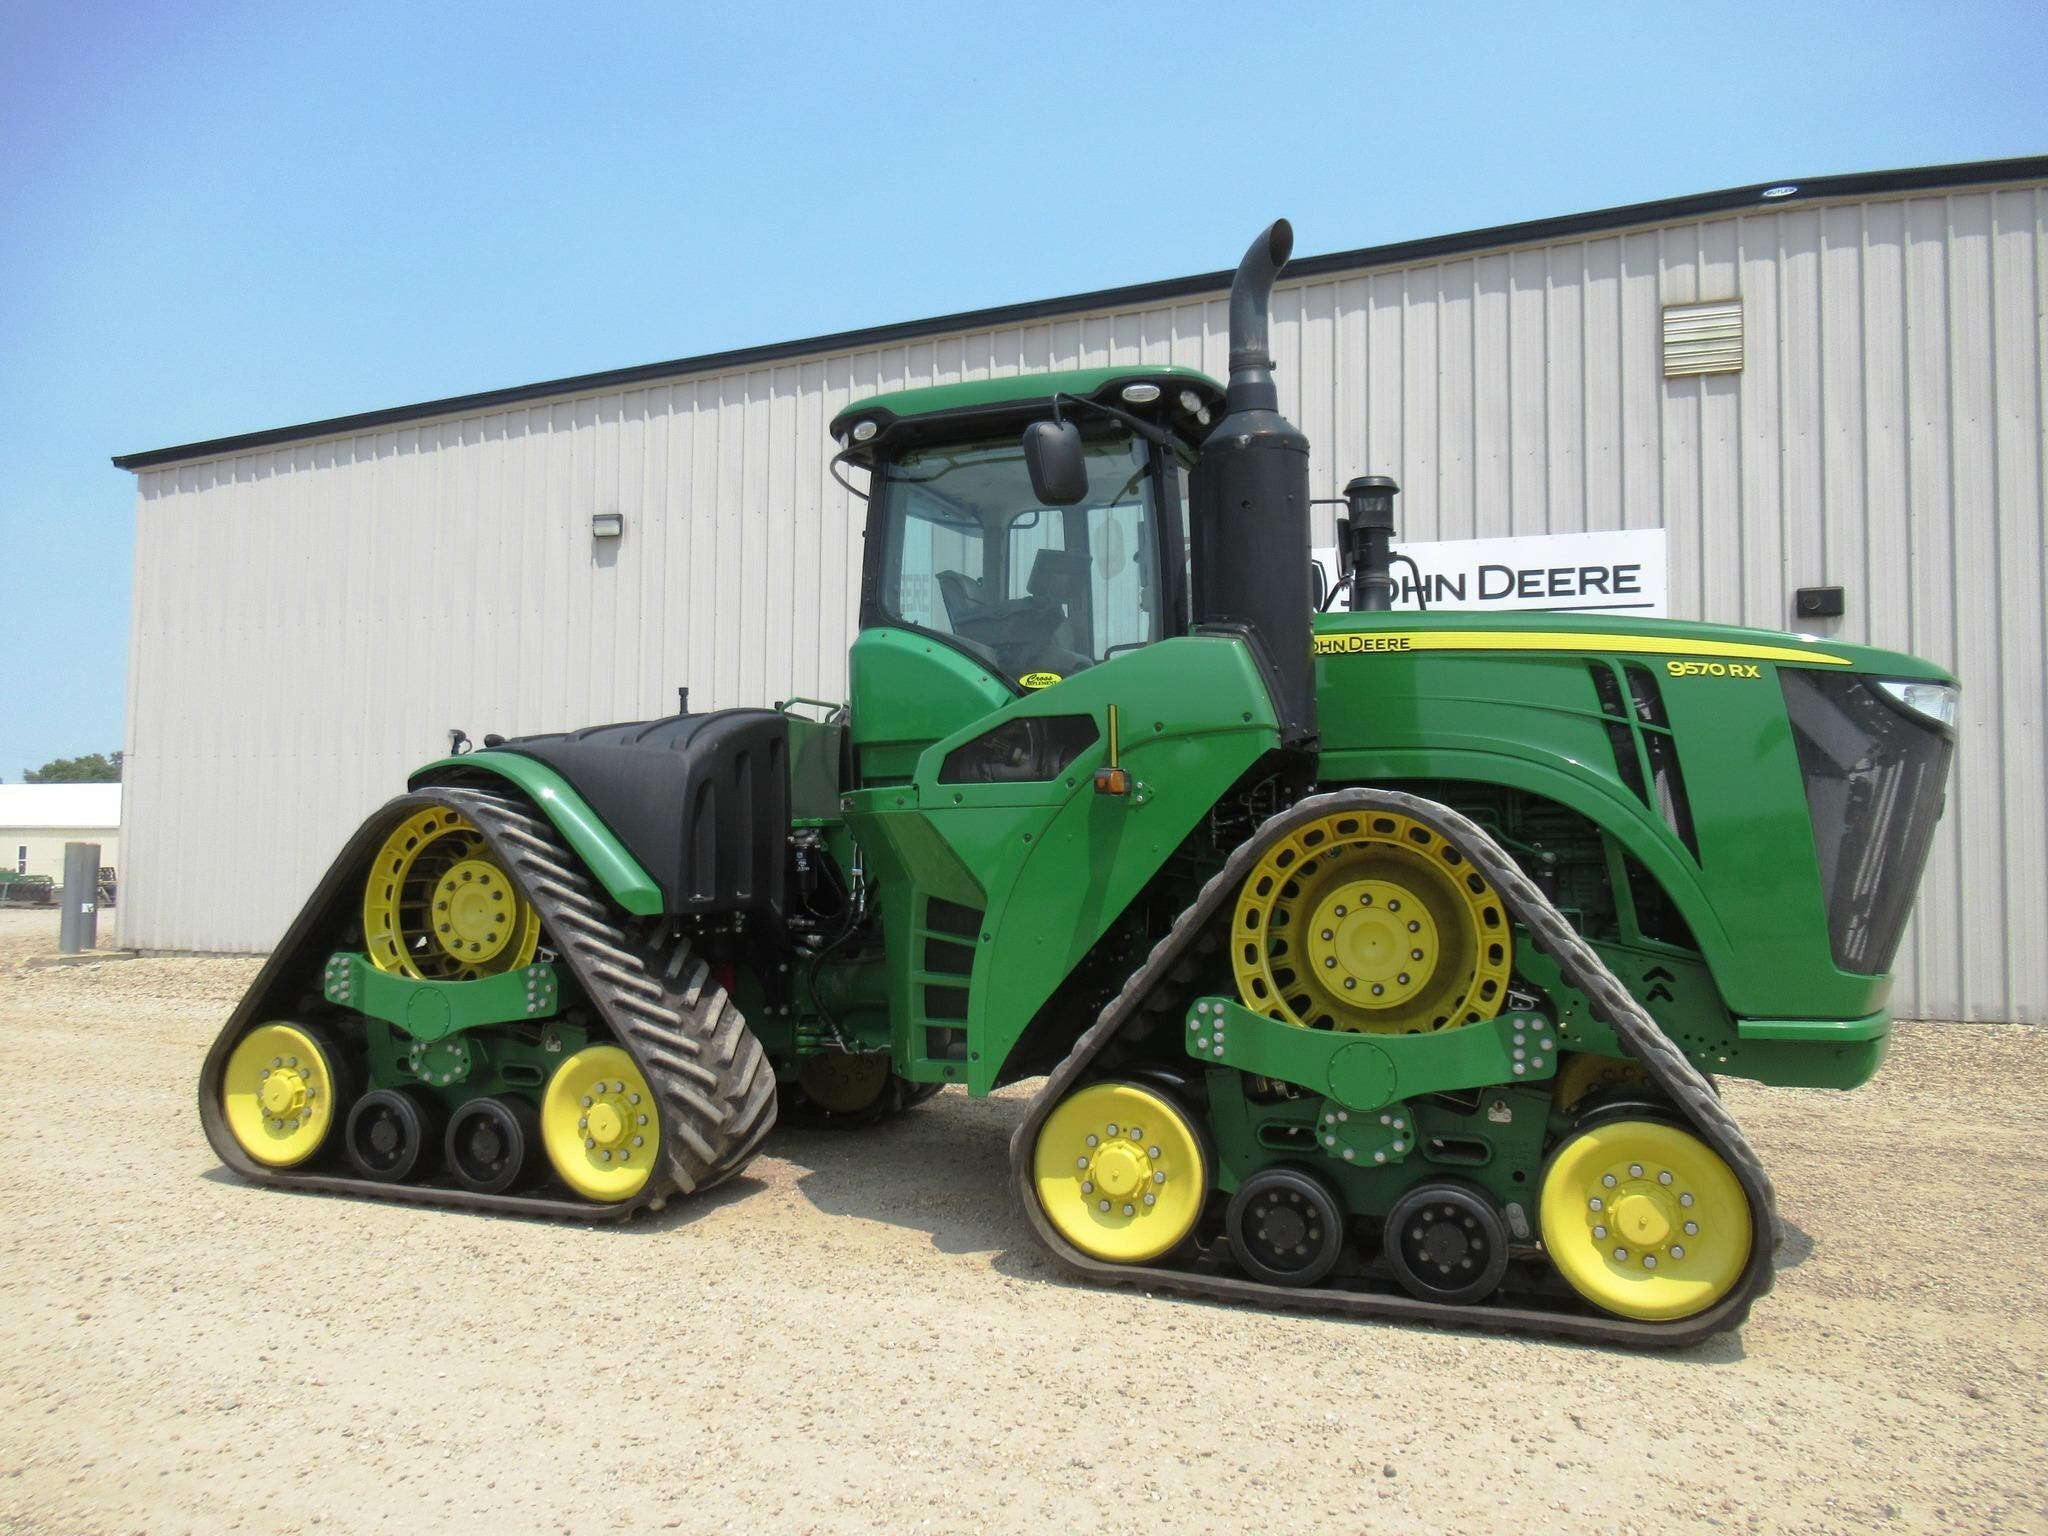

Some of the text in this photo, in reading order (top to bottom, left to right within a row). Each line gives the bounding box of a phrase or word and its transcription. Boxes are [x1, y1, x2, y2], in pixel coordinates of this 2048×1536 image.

[1478, 564, 1641, 600] DEERE
[1349, 636, 1411, 651] DEERE
[1666, 660, 1762, 678] 9570 RX
[1027, 673, 1053, 682] Cross
